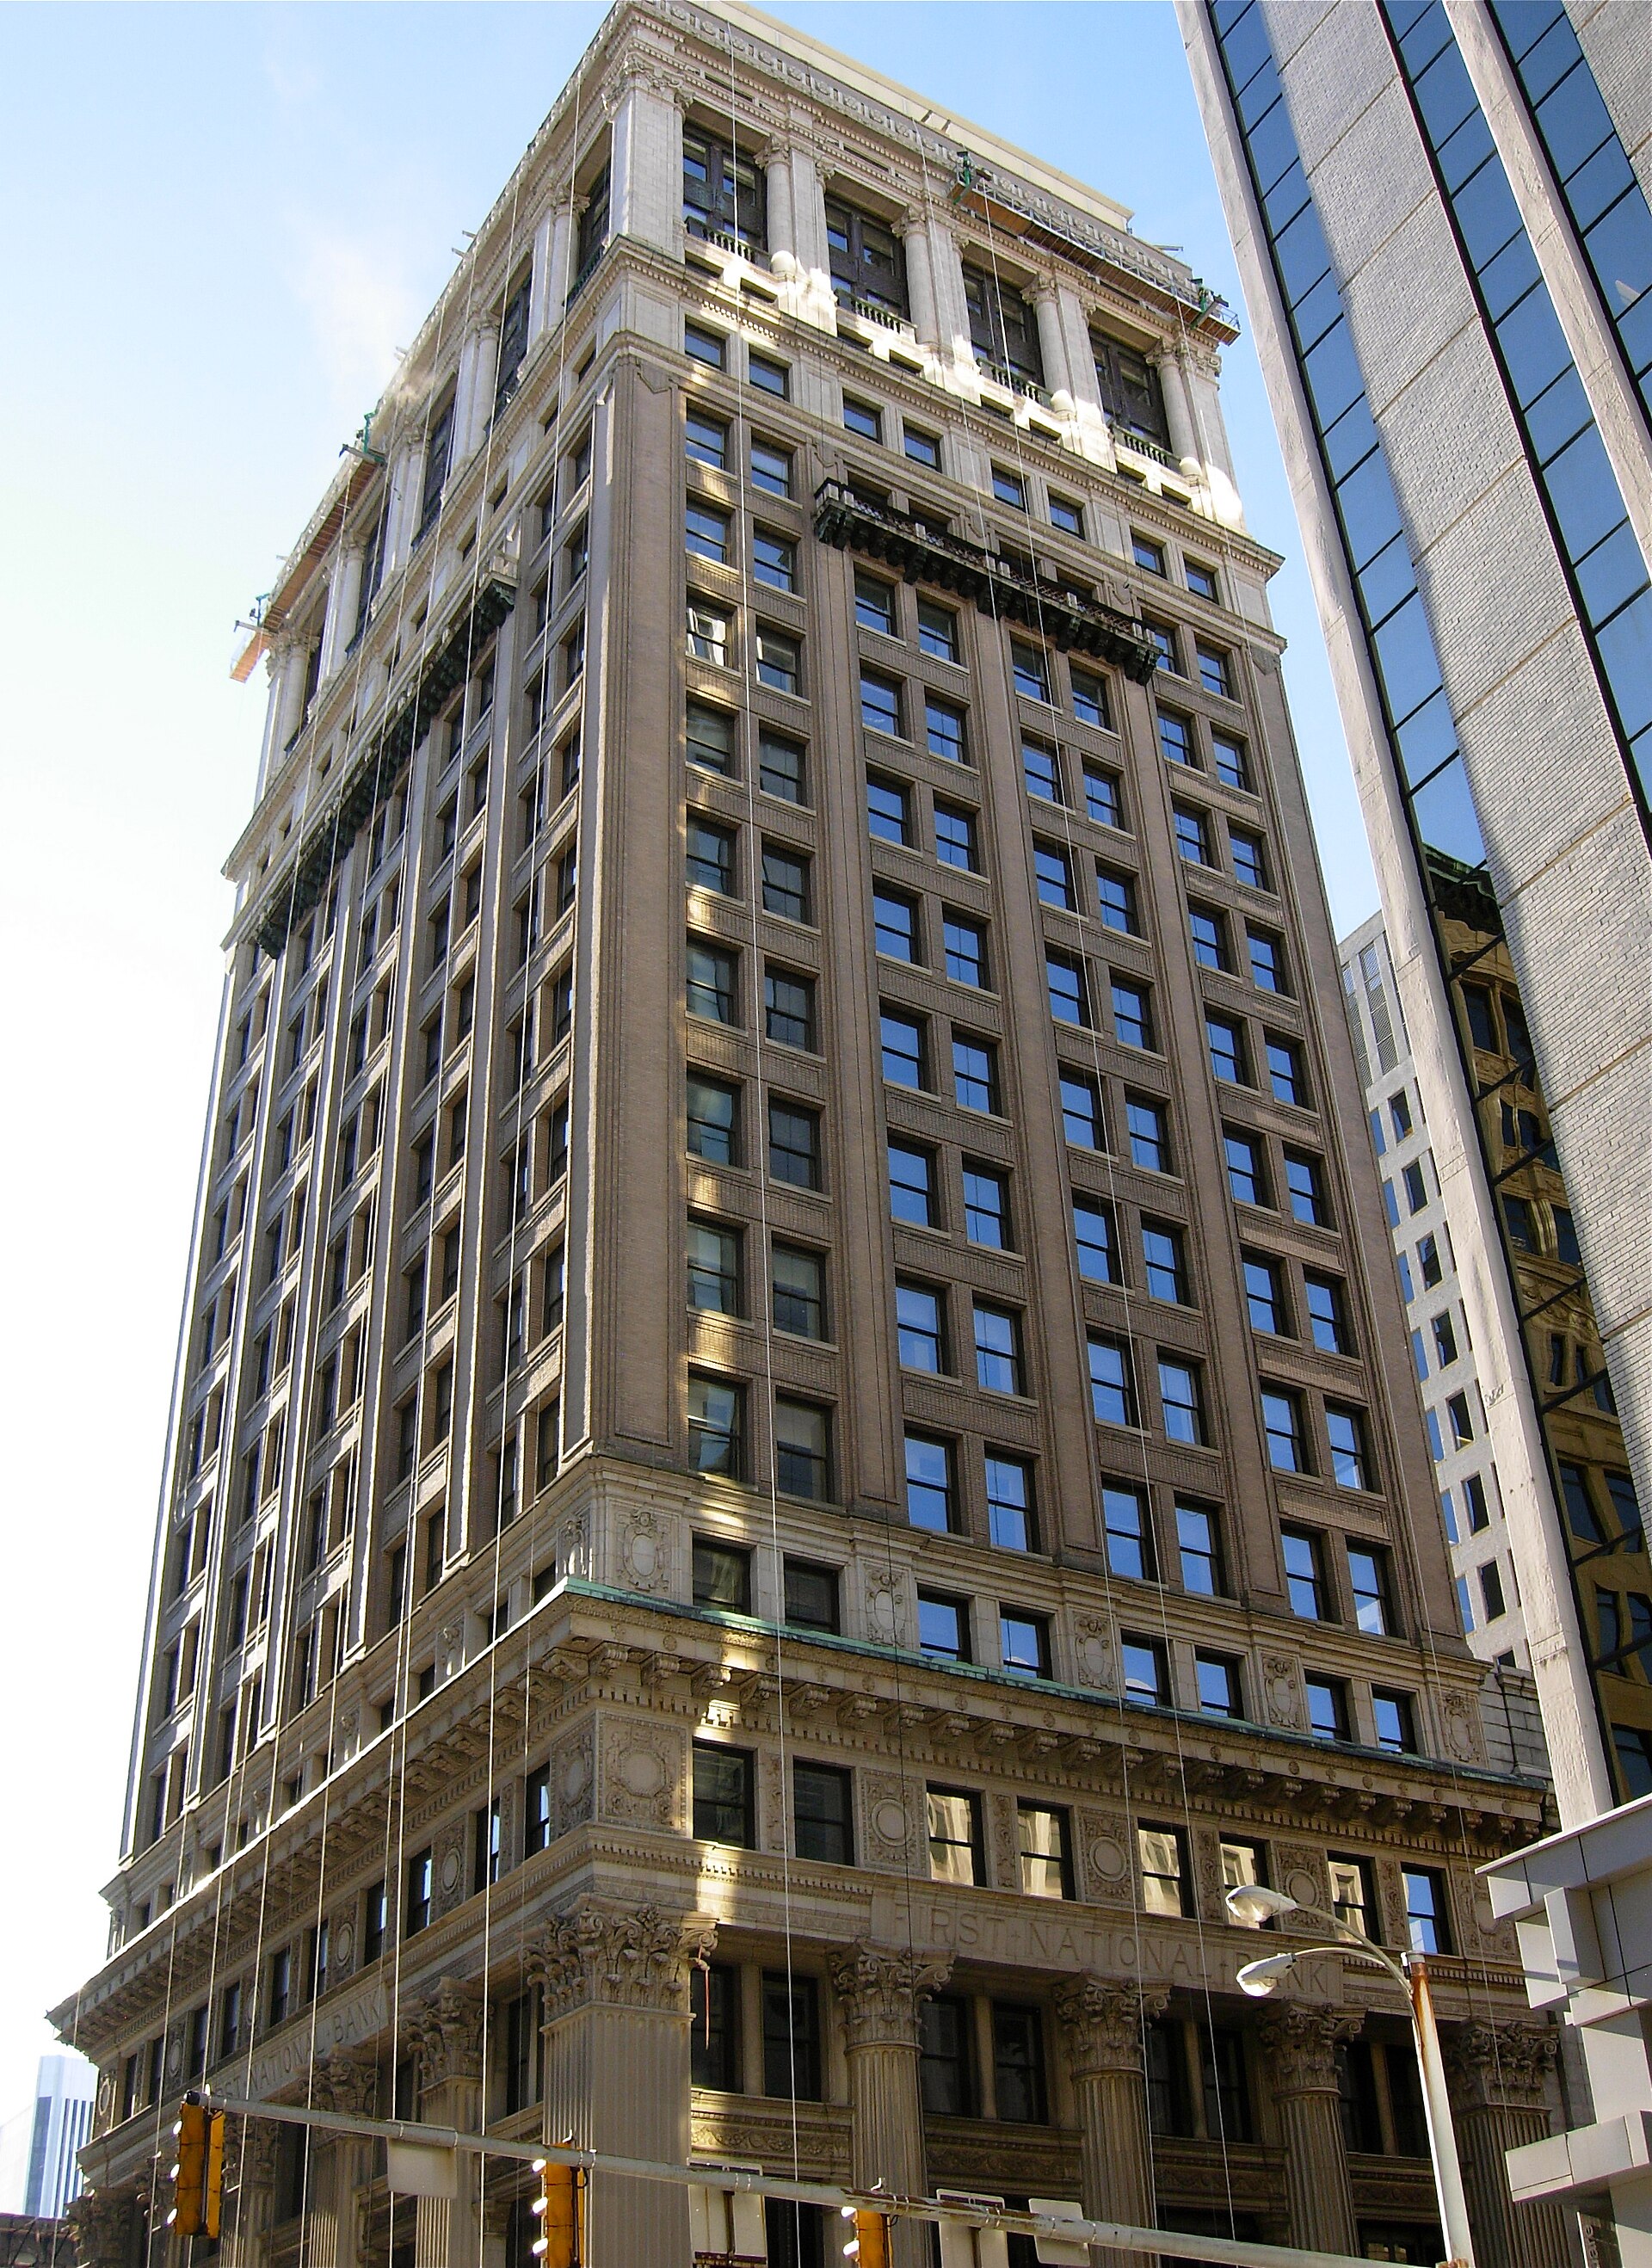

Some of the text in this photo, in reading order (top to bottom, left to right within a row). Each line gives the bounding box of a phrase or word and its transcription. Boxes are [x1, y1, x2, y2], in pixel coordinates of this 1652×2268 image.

[894, 1902, 1004, 1950] FIRST
[1026, 1921, 1212, 1977] NATIONAL
[333, 1990, 382, 2043] BANK
